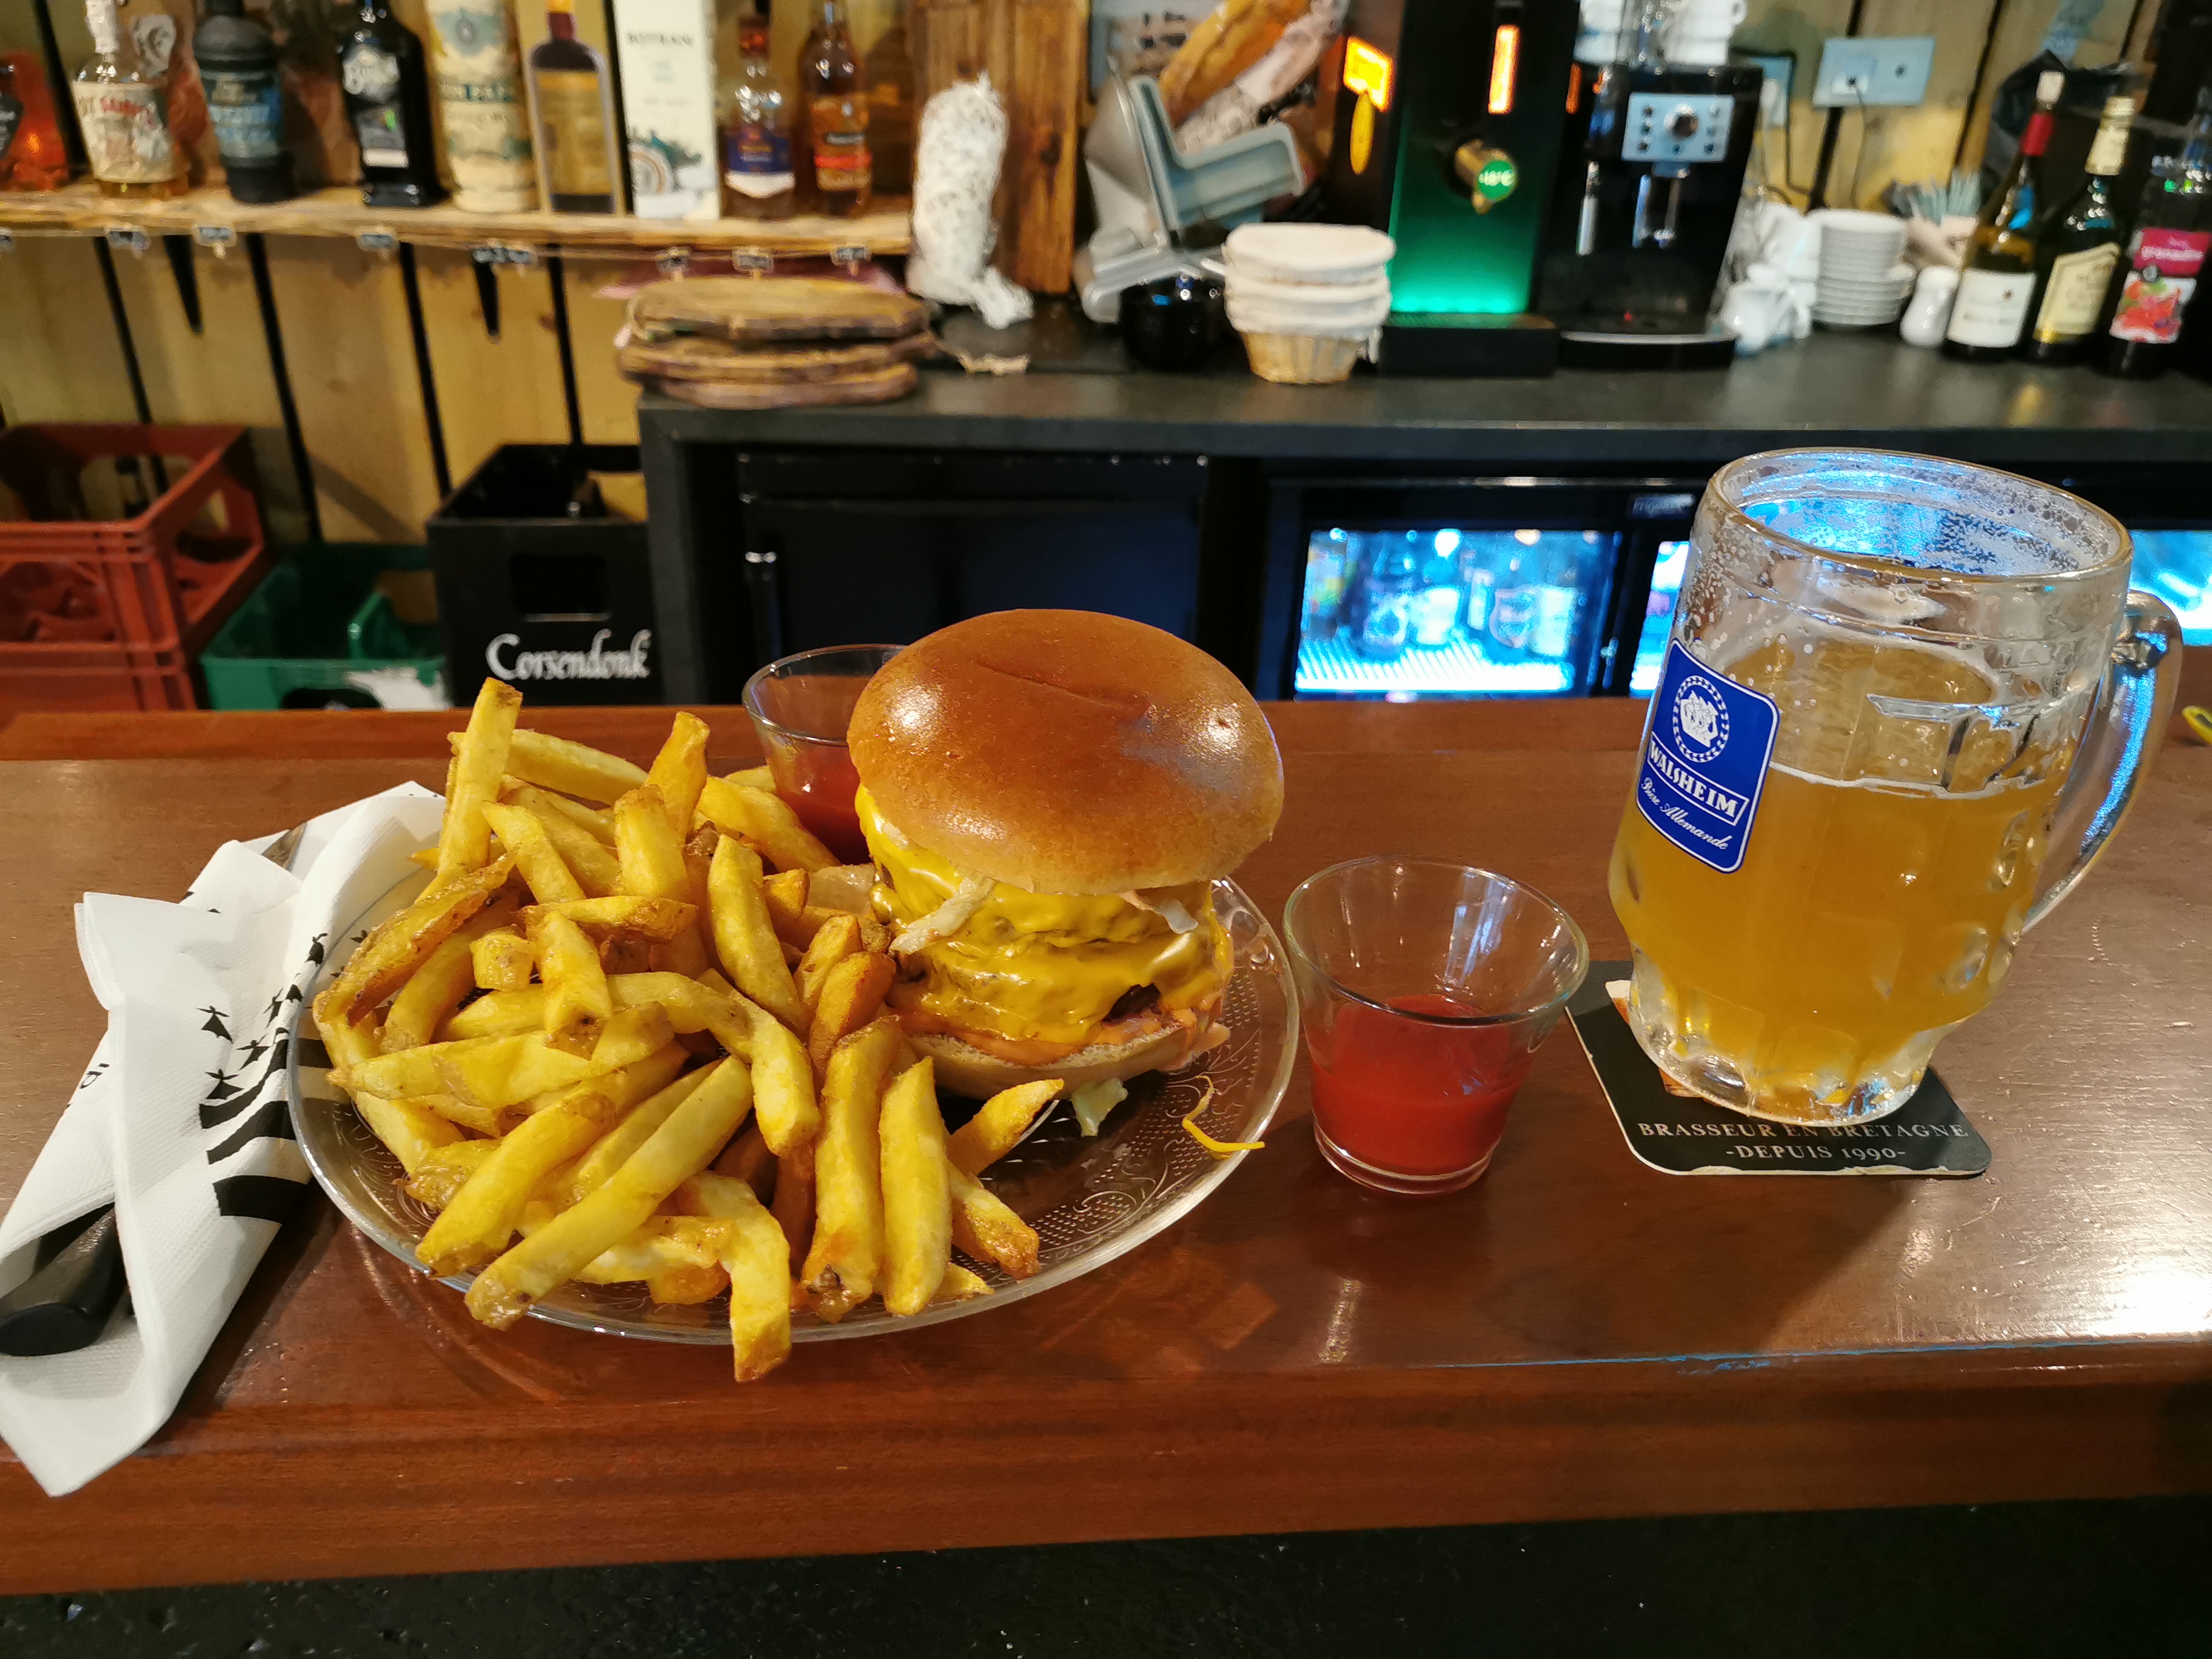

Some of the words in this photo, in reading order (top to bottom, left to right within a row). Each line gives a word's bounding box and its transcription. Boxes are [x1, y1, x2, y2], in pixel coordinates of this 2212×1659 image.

[1650, 740, 1738, 817] WALSHEIM
[1660, 803, 1732, 850] Allemande
[1637, 1123, 1777, 1137] BRASSEUR
[1781, 1123, 1819, 1137] EN
[1826, 1124, 1969, 1138] BRETAGNE
